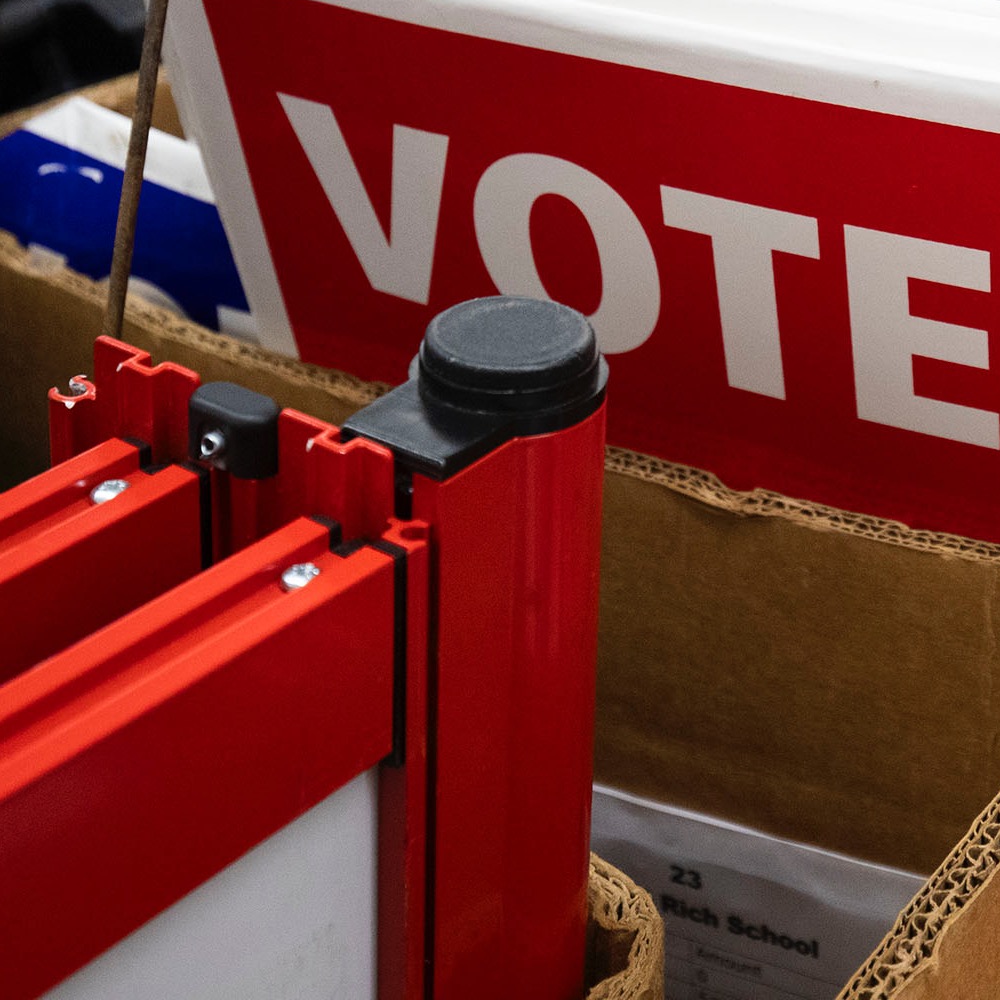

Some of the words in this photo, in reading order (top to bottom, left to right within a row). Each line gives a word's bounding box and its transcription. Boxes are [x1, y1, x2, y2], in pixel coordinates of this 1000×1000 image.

[276, 91, 1000, 450] VOTE
[669, 864, 703, 890] 23
[660, 894, 720, 929] Rich
[727, 914, 820, 959] School
